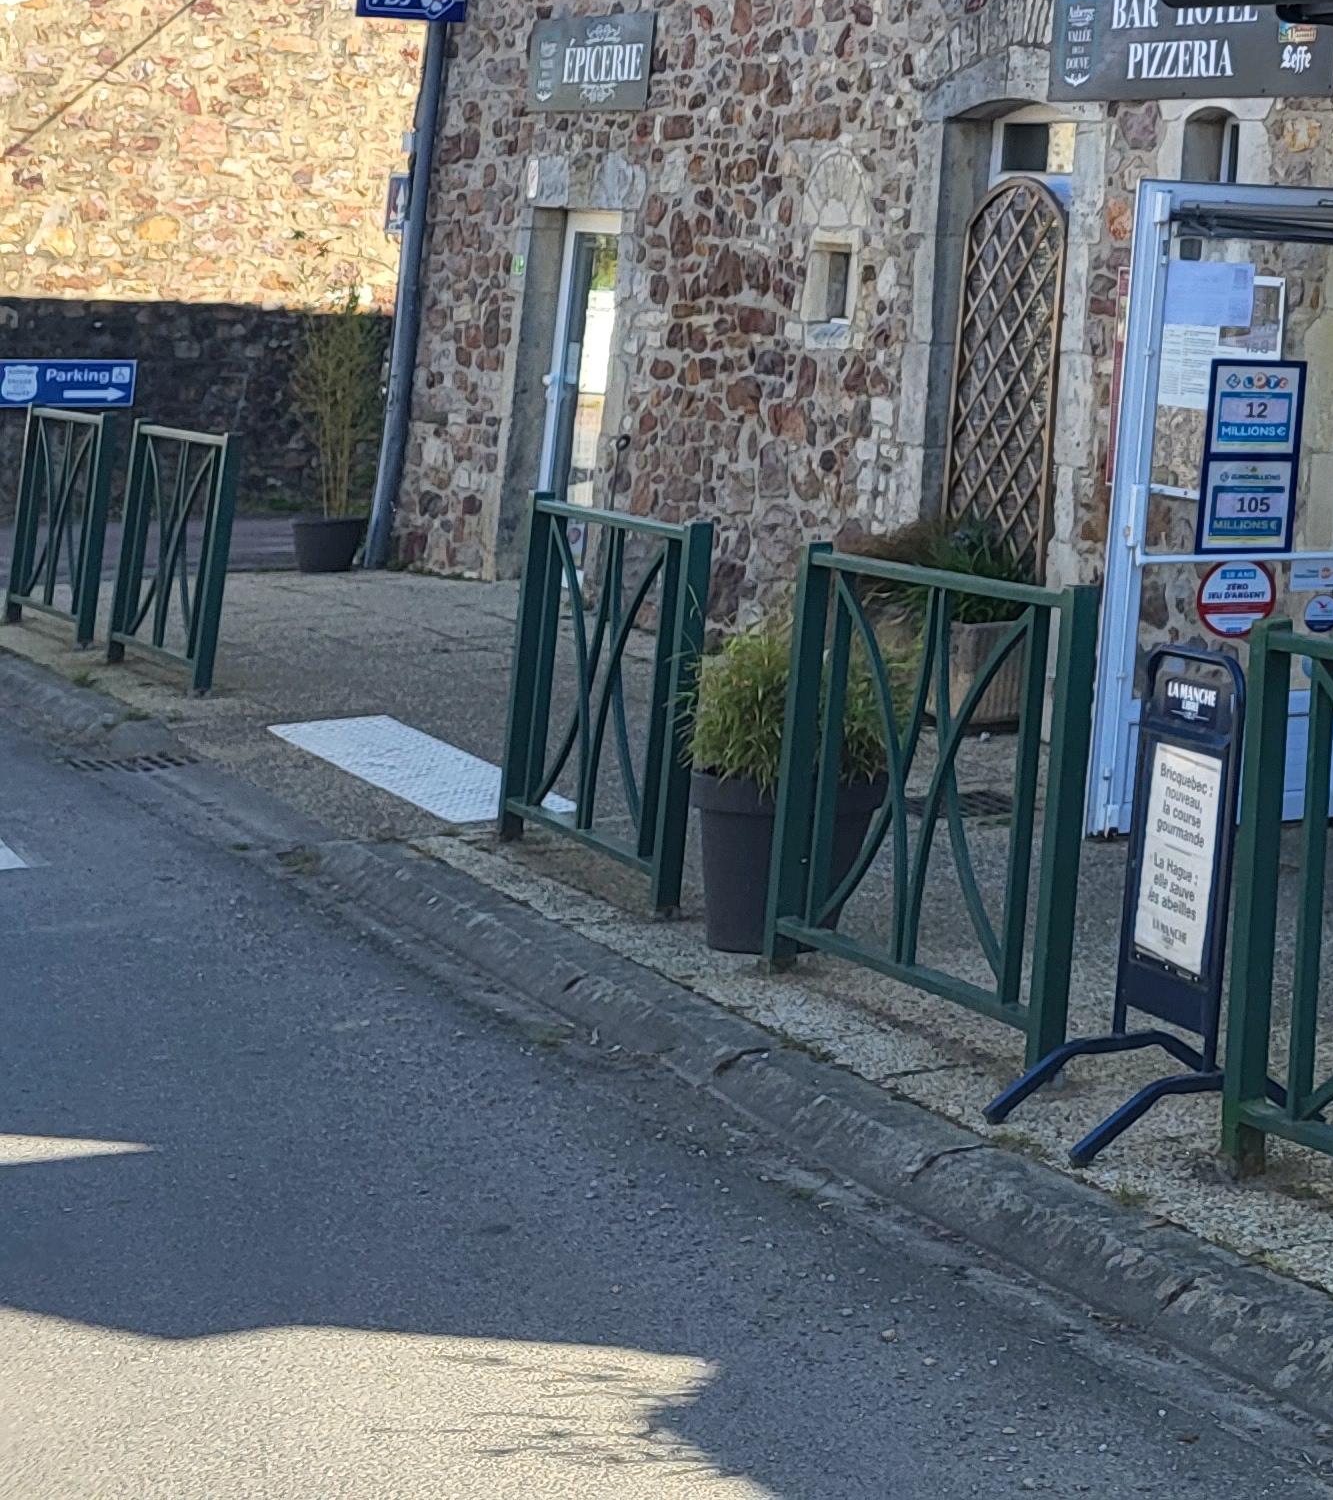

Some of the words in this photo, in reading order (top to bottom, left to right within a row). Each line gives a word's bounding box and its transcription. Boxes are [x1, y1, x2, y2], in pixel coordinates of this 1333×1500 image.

[561, 37, 644, 84] ÉPICERIE
[1126, 39, 1235, 80] PIZZERIA
[1280, 44, 1312, 75] Leffe
[45, 368, 110, 385] Parking
[1245, 401, 1268, 419] 12
[1221, 425, 1276, 437] MILLIONS
[1276, 426, 1286, 437] €
[1236, 496, 1271, 514] 105
[1213, 520, 1268, 530] MILLIONS
[1224, 591, 1266, 599] D'ARGENT
[1167, 681, 1179, 698] LA
[1180, 683, 1218, 708] MANCHE
[1160, 762, 1208, 796] Bricquebec
[1162, 799, 1171, 816] la
[1173, 807, 1202, 829] course
[1165, 786, 1203, 814] nouveau,
[1156, 818, 1204, 848] gourmande
[1154, 851, 1165, 870] La
[1167, 858, 1193, 883] Hague
[1153, 872, 1168, 890] elle
[1169, 881, 1195, 902] sauve
[1147, 885, 1160, 905] les
[1161, 895, 1197, 921] abeilles
